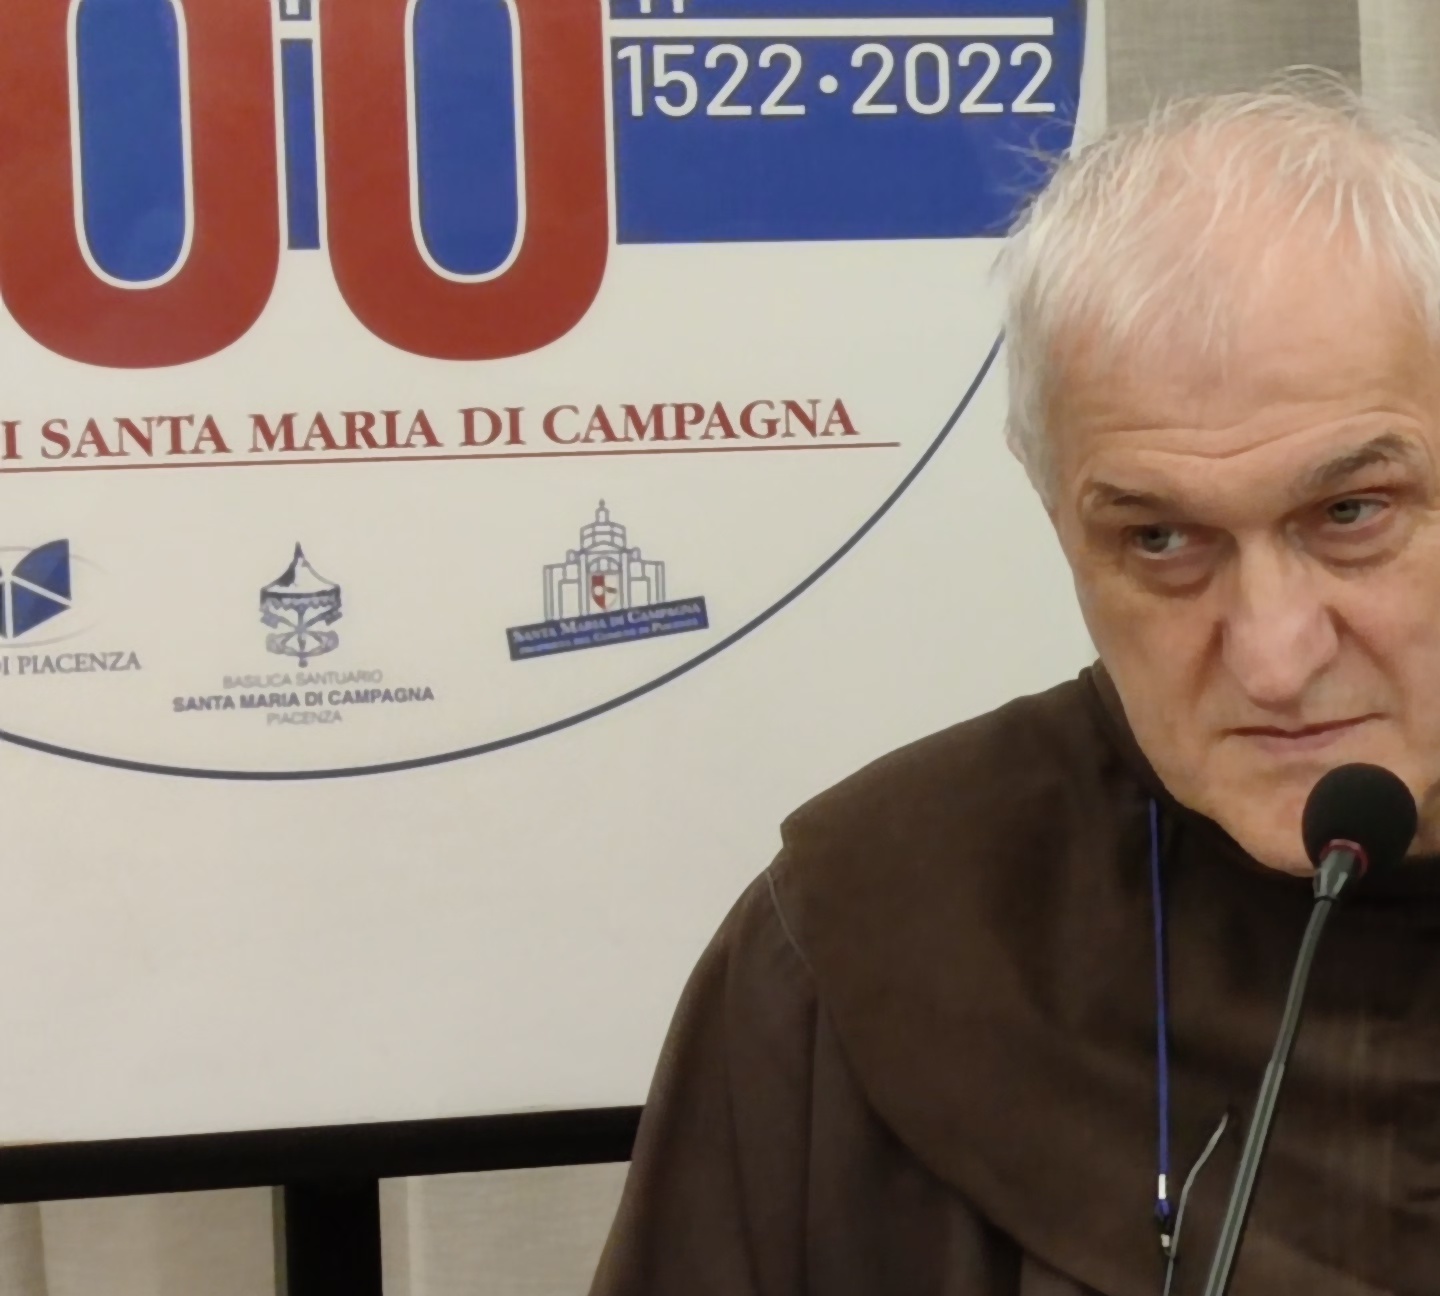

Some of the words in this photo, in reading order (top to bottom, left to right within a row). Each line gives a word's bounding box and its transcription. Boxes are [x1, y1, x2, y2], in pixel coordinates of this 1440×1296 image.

[40, 413, 234, 460] SANTA
[248, 408, 446, 454] MARIA
[458, 406, 528, 448] DI
[542, 397, 861, 445] CAMPAGNA
[17, 651, 143, 676] PIACENZA
[222, 672, 293, 689] BASILICA
[295, 668, 384, 687] SANTUARIO
[172, 694, 236, 713] SANTA
[239, 691, 301, 709] MARIA
[304, 690, 324, 707] DI
[327, 685, 436, 706] CAMPAGNA
[266, 709, 343, 727] PIACENZA
